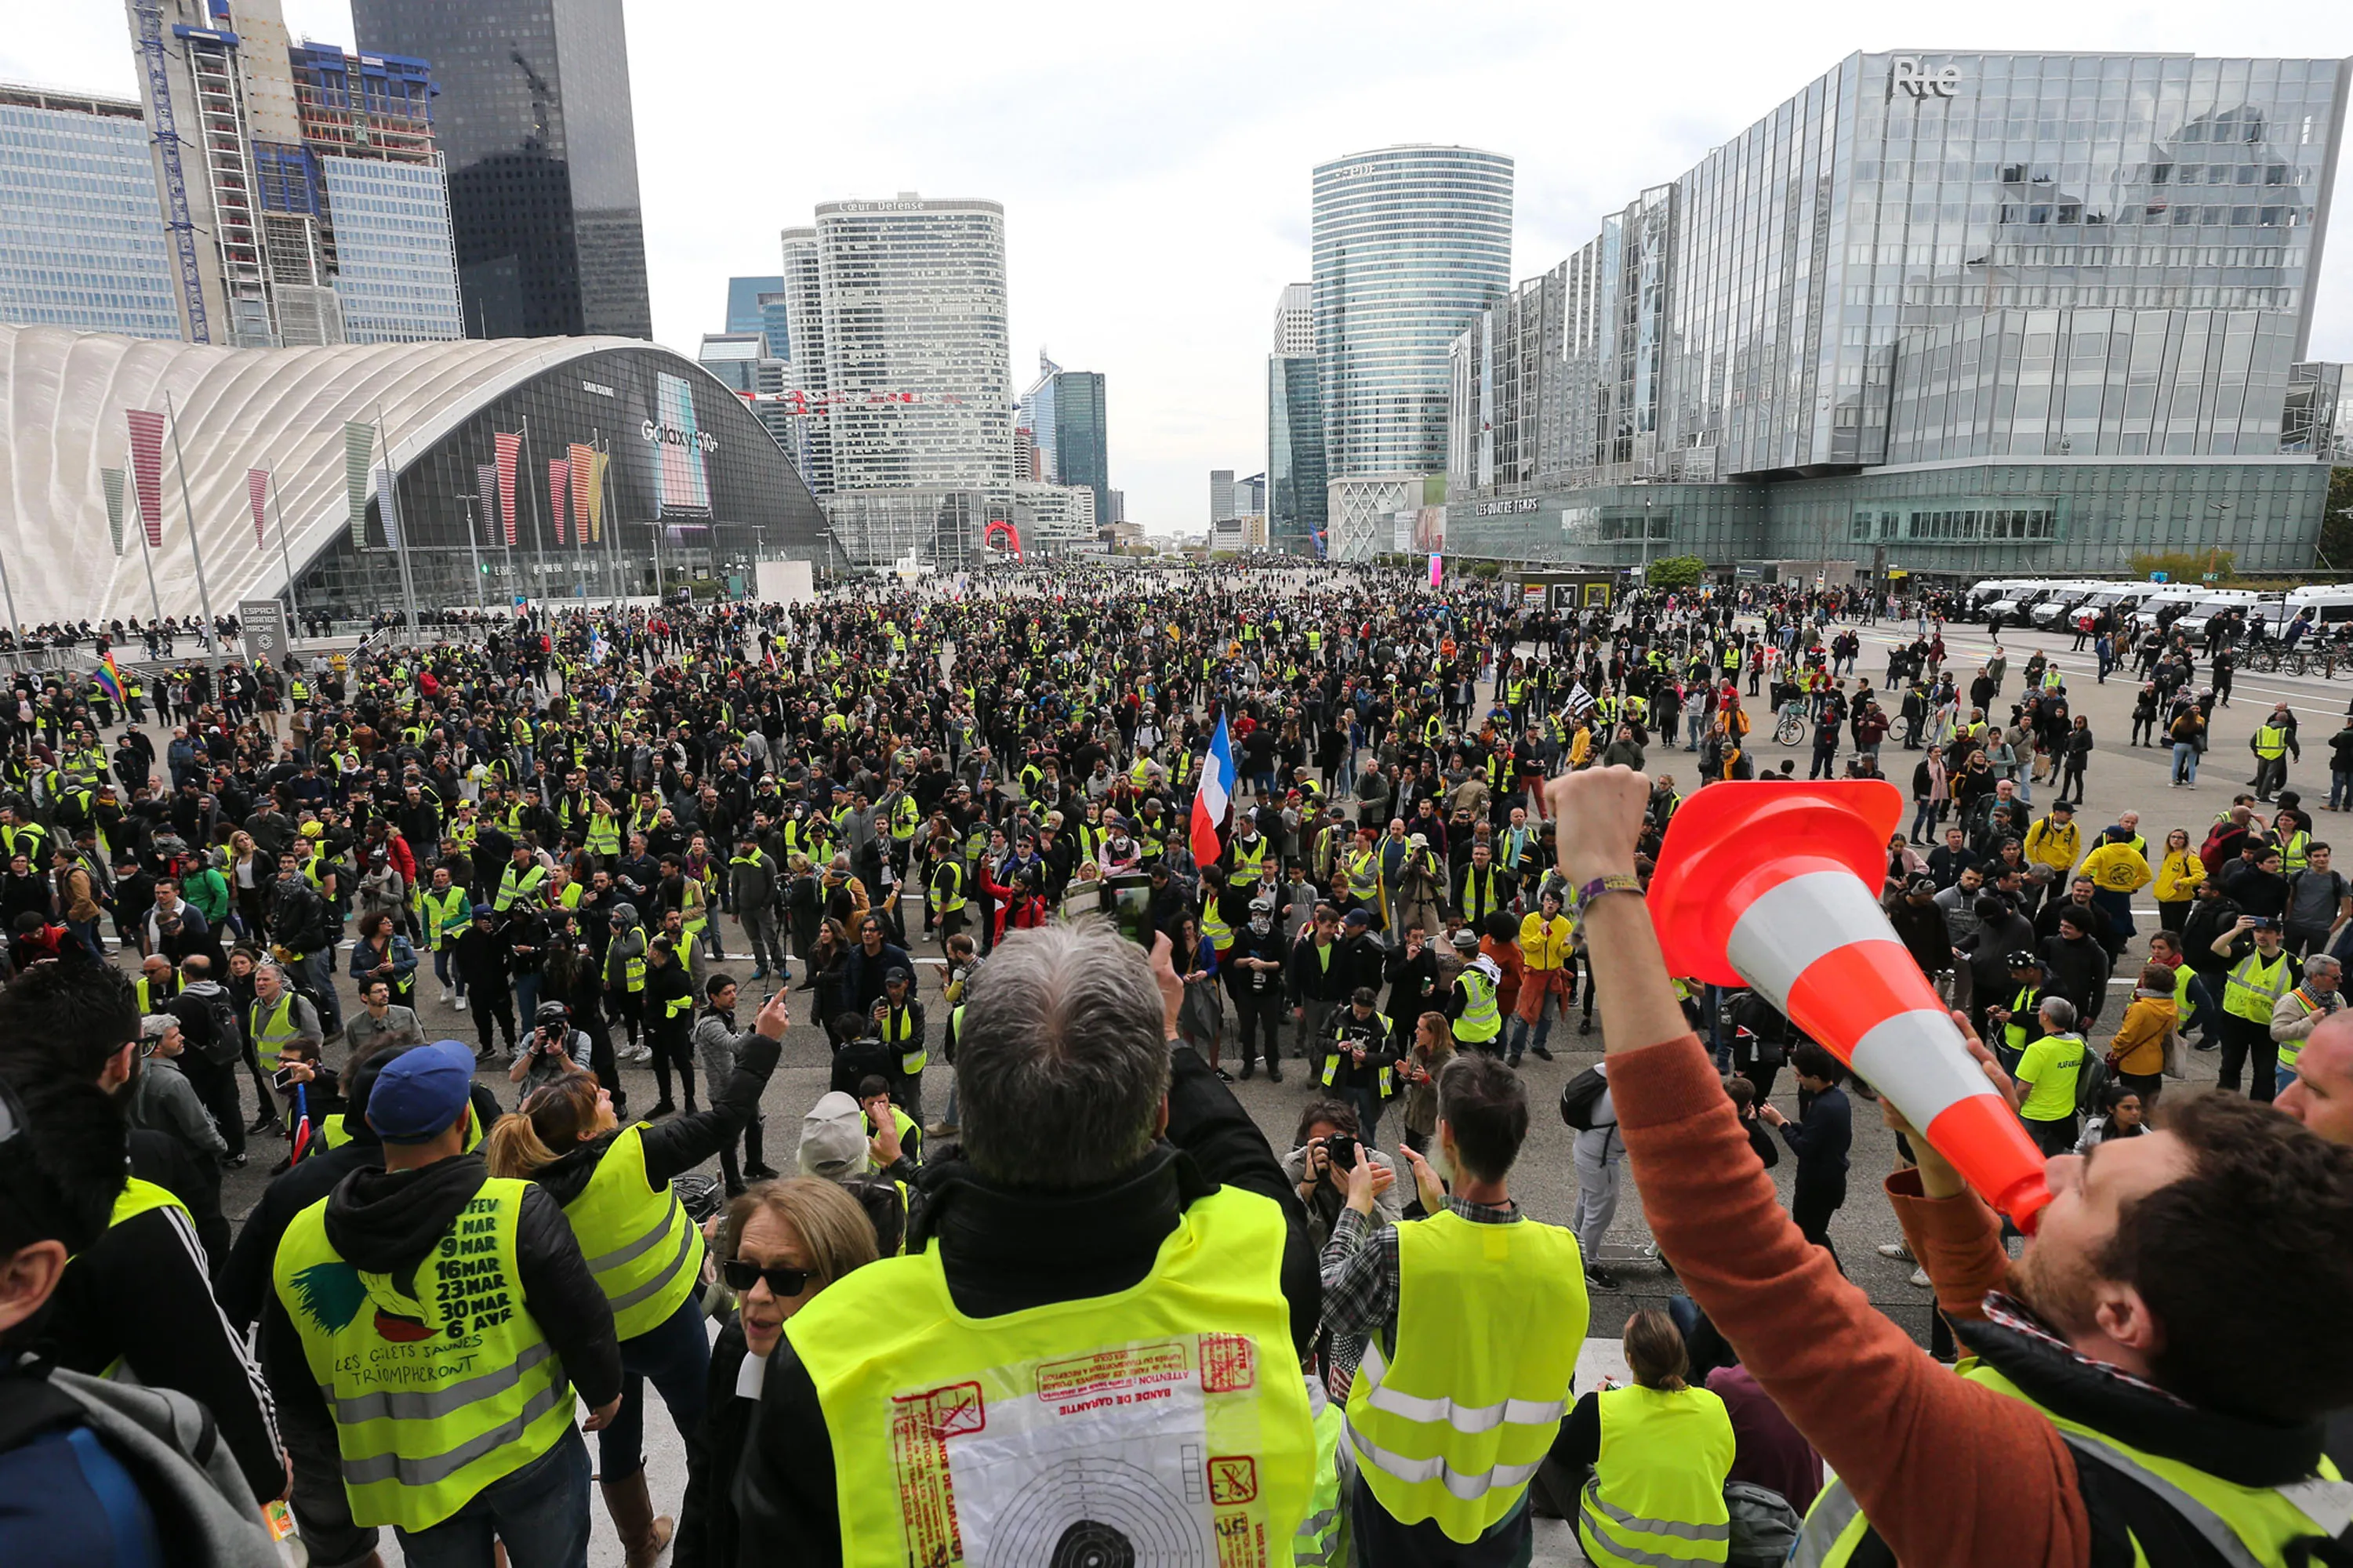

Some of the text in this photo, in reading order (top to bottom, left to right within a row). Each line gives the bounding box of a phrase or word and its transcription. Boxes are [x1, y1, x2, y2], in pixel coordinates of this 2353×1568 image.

[1892, 56, 1962, 95] Rte
[641, 419, 719, 455] Galaxy S10+
[1476, 497, 1539, 517] LES QUATRE TEMPS
[242, 606, 278, 615] ESPACE
[244, 615, 280, 624] GRANDE
[245, 624, 274, 633] ARCHE
[470, 1198, 499, 1214] FEV
[463, 1217, 496, 1235] MAR
[441, 1236, 497, 1258] 9 MAR
[438, 1293, 512, 1321] 30 MAR
[447, 1308, 514, 1339] 6 AVR
[335, 1354, 360, 1372] LES
[423, 1334, 483, 1358] JAUNES
[1139, 1370, 1189, 1385] ATTENTION
[1059, 1388, 1171, 1416] BANDE DE GARANTIE
[942, 1473, 952, 1490] DE
